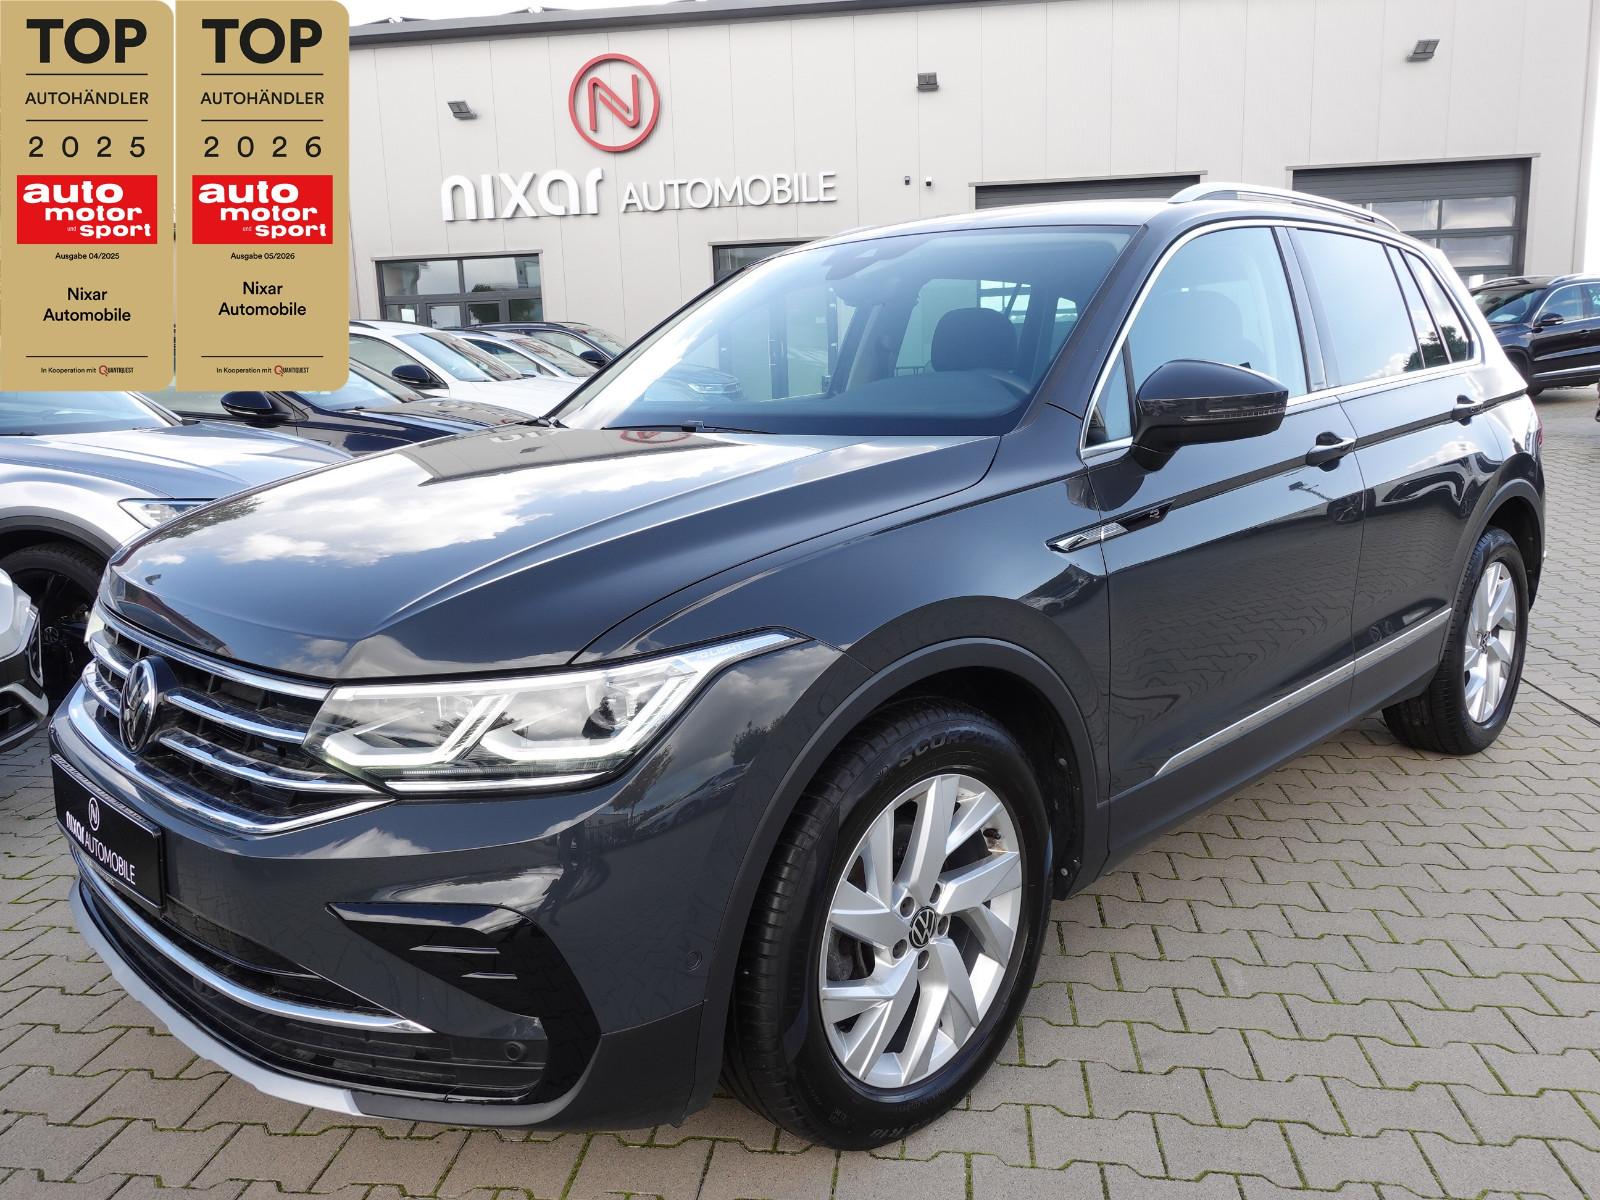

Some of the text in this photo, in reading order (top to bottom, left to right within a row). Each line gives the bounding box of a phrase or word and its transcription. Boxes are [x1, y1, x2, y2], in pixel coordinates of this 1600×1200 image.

[441, 168, 838, 222] nixar AUTOMOBILE
[66, 810, 136, 886] nixar AUTOMOBILE
